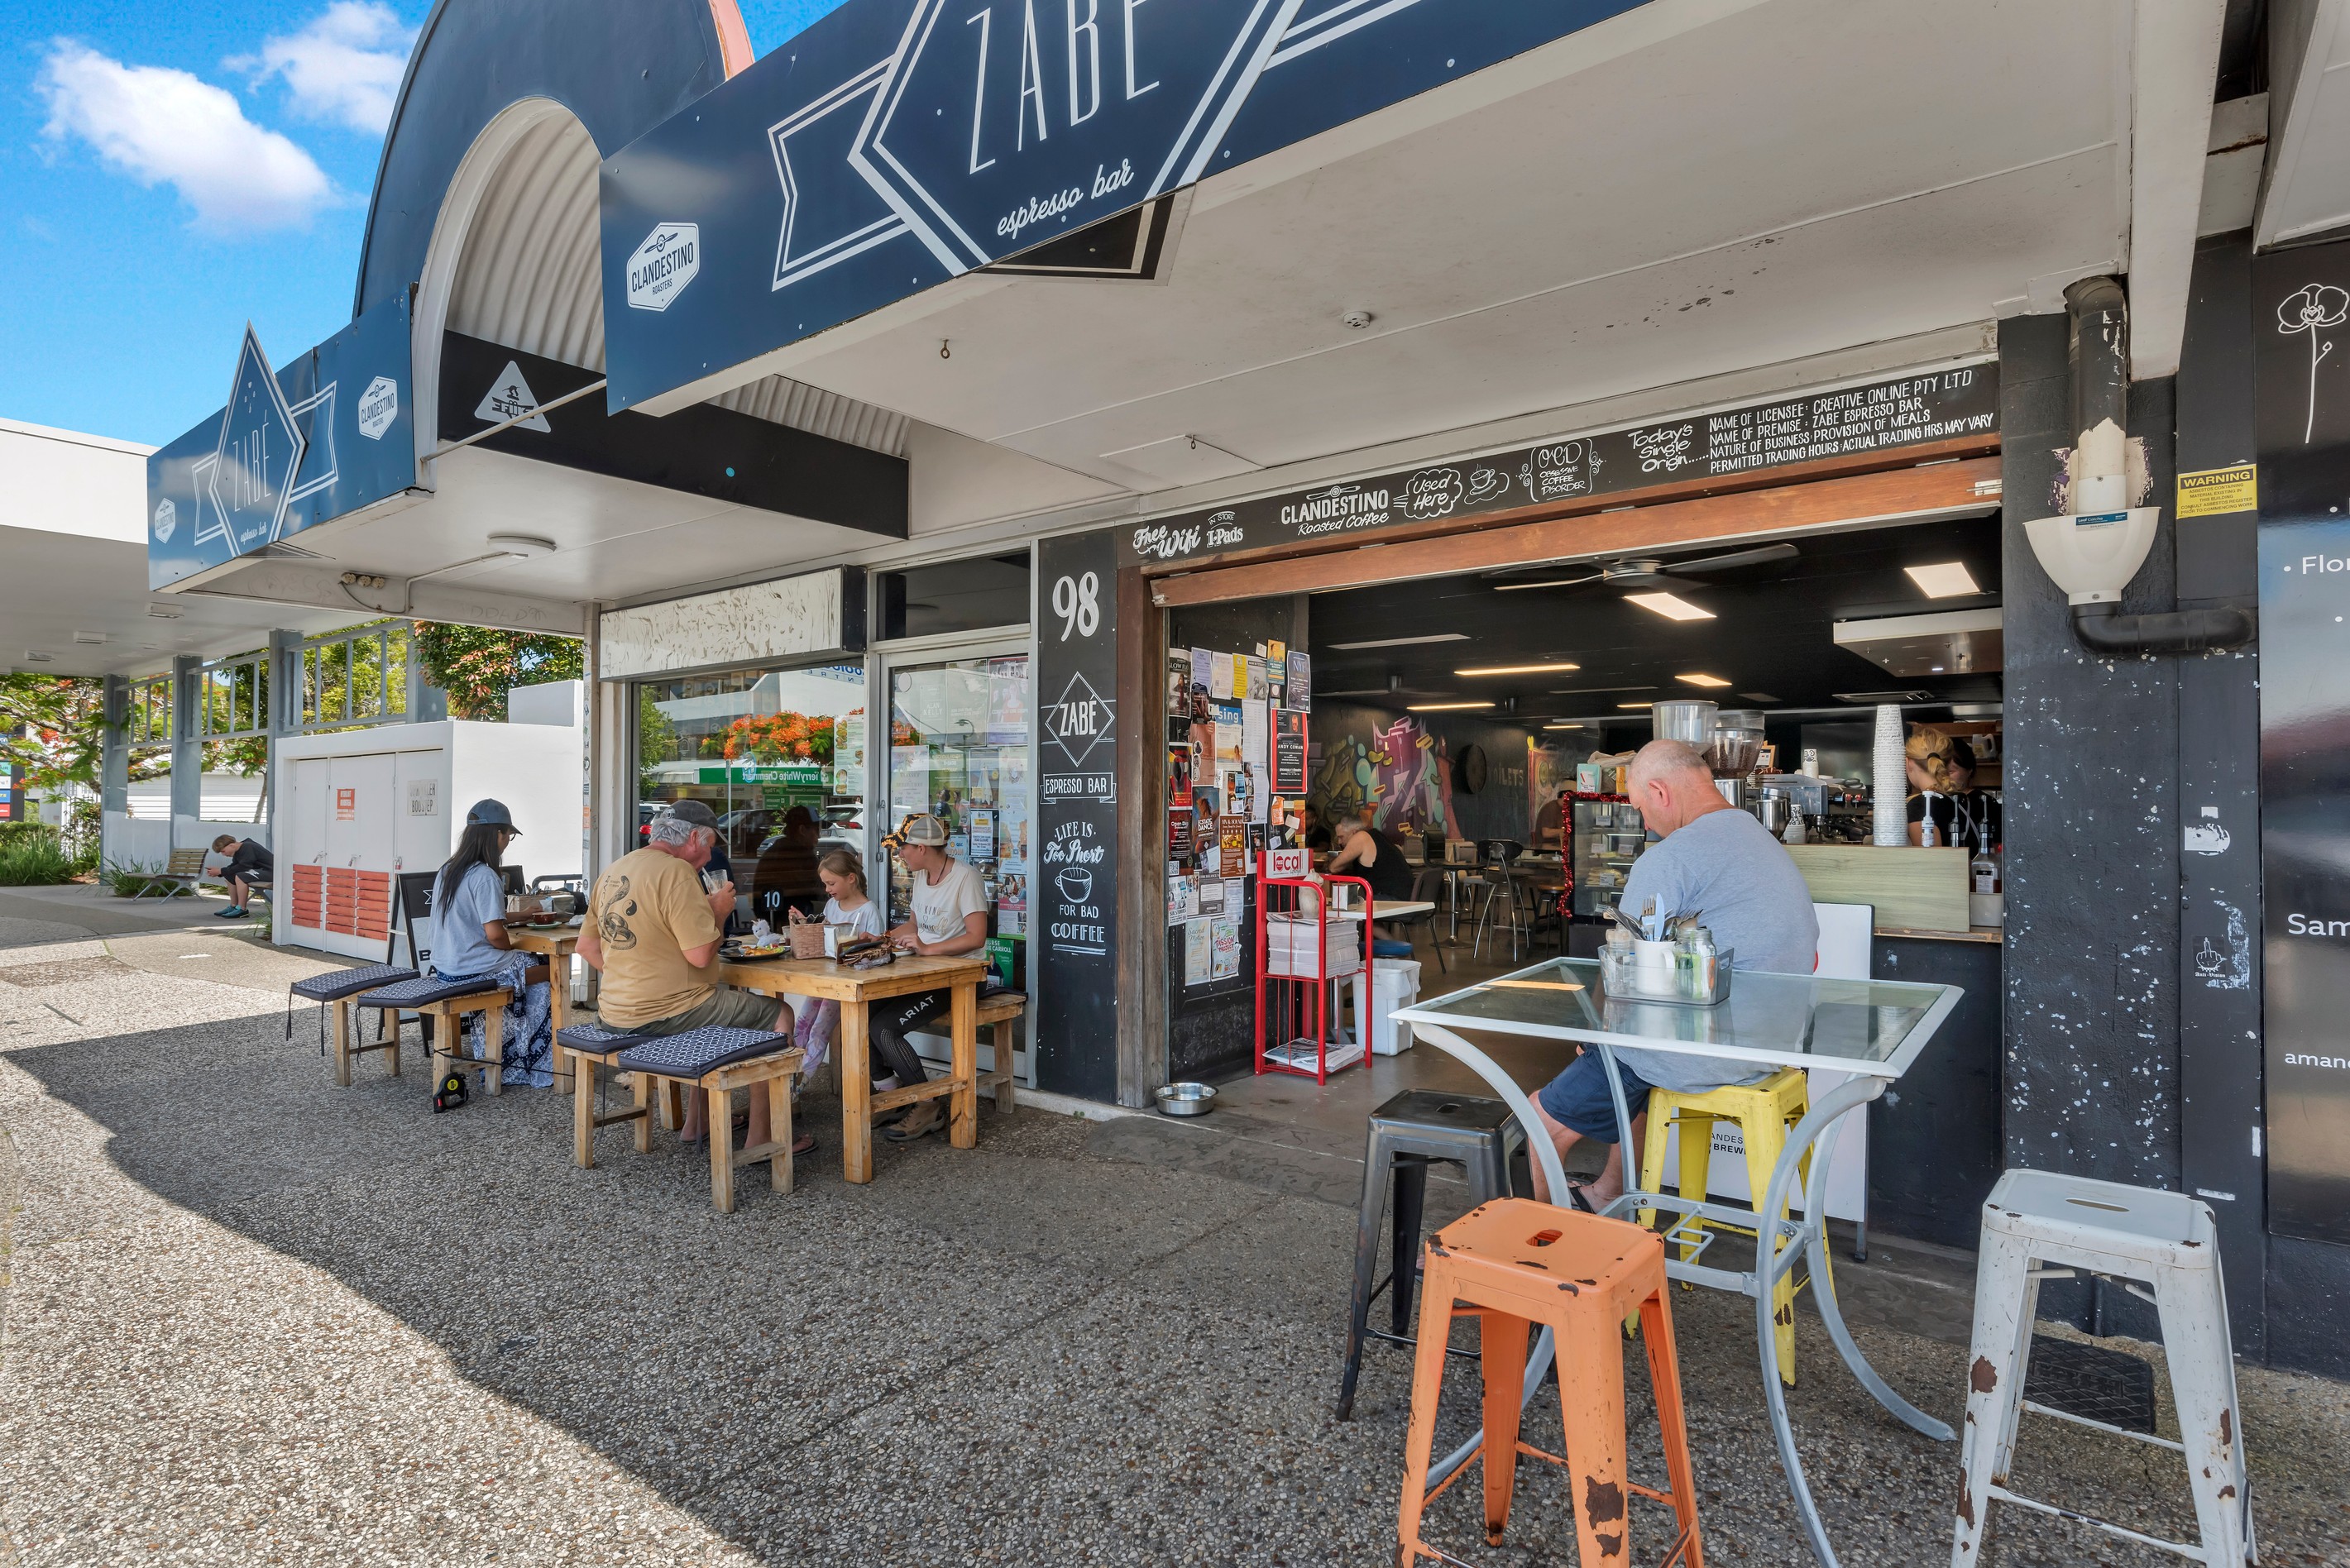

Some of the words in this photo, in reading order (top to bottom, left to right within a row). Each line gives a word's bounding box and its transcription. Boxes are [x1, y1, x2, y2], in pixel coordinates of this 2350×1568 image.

[997, 191, 1083, 237] espresso
[1091, 157, 1136, 200] bar
[631, 241, 694, 293] CLANDESTINO
[652, 278, 672, 295] ROASTERS
[361, 392, 395, 424] CLANDESTINO
[1709, 415, 1739, 433] NAME
[1740, 413, 1752, 426] OF
[1813, 391, 1864, 414] CREATIVE
[1868, 382, 1910, 404] ONLINE
[1914, 376, 1939, 396] PTY
[1945, 370, 1972, 390] LTD
[1709, 430, 1739, 447] NAME
[1741, 428, 1753, 440] OF
[1812, 411, 1840, 428] ZABE
[1845, 403, 1894, 423] ESPRESSO
[1898, 397, 1923, 414] BAR
[1627, 423, 1693, 449] Today's
[1710, 442, 1747, 460] NATURE
[1749, 439, 1762, 452] OF
[1813, 421, 1871, 442] PROVISION
[1874, 418, 1887, 431] OF
[1891, 409, 1931, 428] MEALS
[1711, 454, 1763, 475] PERMITTED
[1765, 447, 1807, 464] TRADING
[1842, 435, 1877, 452] ACTUAL
[1879, 426, 1922, 446] TRADING
[1945, 418, 1967, 435] MAY
[1967, 413, 1994, 431] VARY
[1538, 442, 1582, 469] OCD
[1639, 440, 1692, 459] Single
[1539, 465, 1579, 479] OBSESSIVE
[1541, 474, 1574, 486] COFFEE
[2184, 471, 2251, 487] WARNING
[1413, 474, 1453, 495] Used
[1541, 480, 1587, 496] DISORDER
[1280, 489, 1390, 525] CLANDESTINO
[1413, 492, 1449, 512] Here
[1217, 513, 1235, 522] STORE
[1297, 517, 1346, 537] Roasted
[1346, 512, 1390, 529] Coffee
[1132, 524, 1168, 551] Free
[1052, 571, 1099, 643] 98
[1293, 660, 1306, 673] NYE
[1059, 695, 1098, 738] ZABÉ
[1218, 709, 1239, 723] sing
[1045, 778, 1083, 796] ESPRESSO
[1088, 776, 1108, 793] BAR
[1043, 842, 1066, 865] Too
[1069, 838, 1105, 864] Short
[764, 891, 781, 908] 10
[1059, 904, 1077, 917] FOR
[1080, 905, 1099, 919] BAD
[1051, 922, 1105, 944] COFFEE
[899, 995, 936, 1026] ARIAT
[2285, 1053, 2350, 1069] aman
